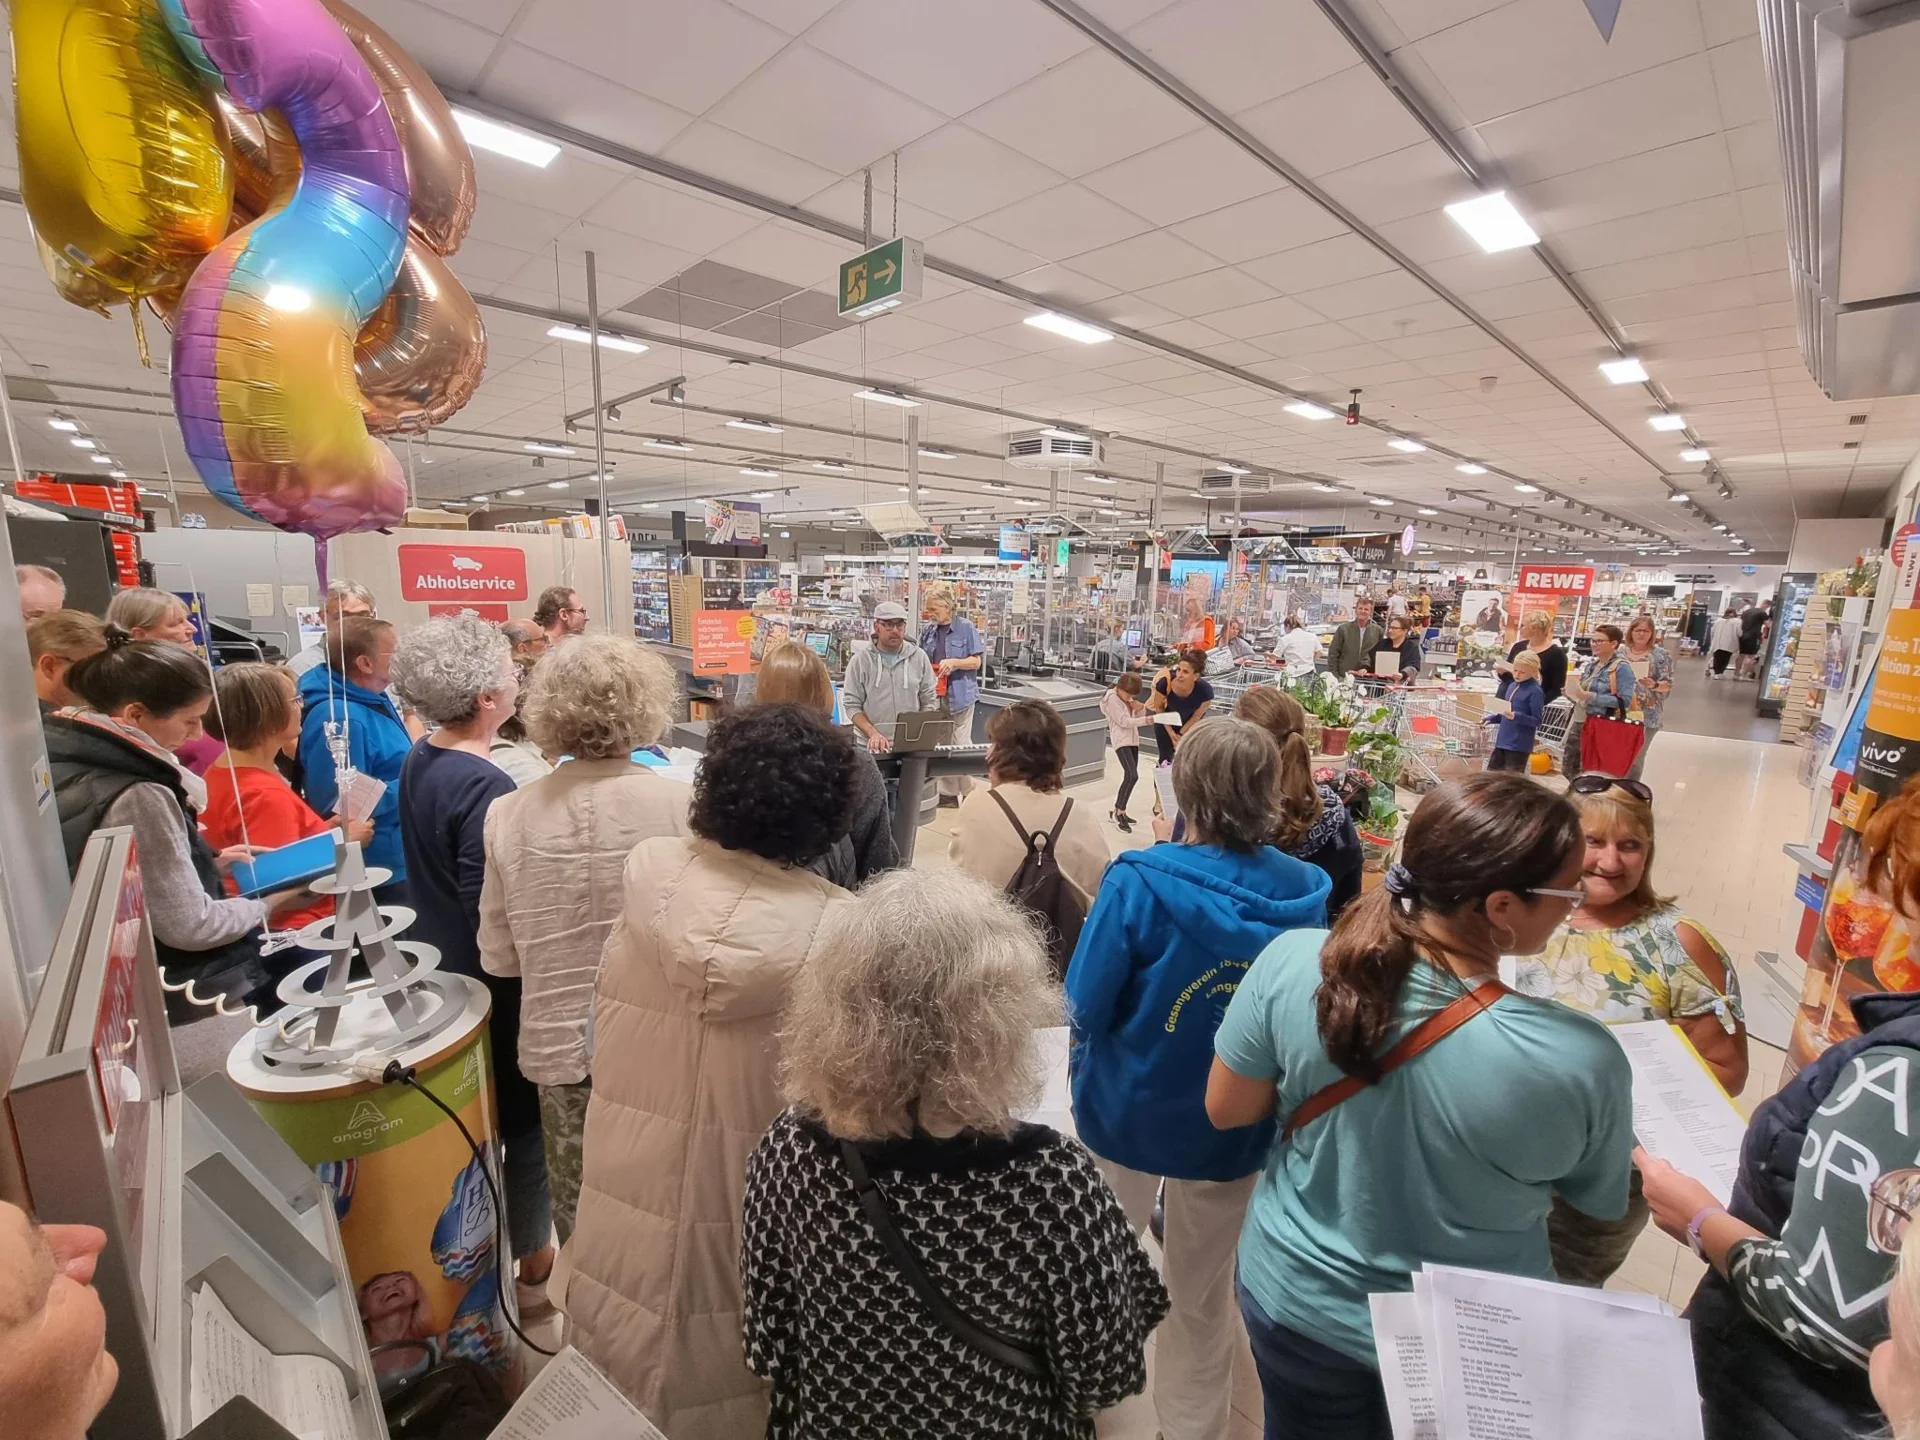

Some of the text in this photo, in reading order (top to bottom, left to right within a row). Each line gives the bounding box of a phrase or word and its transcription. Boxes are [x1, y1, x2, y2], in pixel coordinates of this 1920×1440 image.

[1352, 546, 1387, 561] EAT HAPPY
[1525, 572, 1586, 589] REWE
[1905, 551, 1918, 588] REWE
[416, 575, 516, 590] Abholservice
[1862, 742, 1901, 764] vivo
[1164, 967, 1218, 1033] Gesangverein
[332, 1117, 404, 1144] anagram
